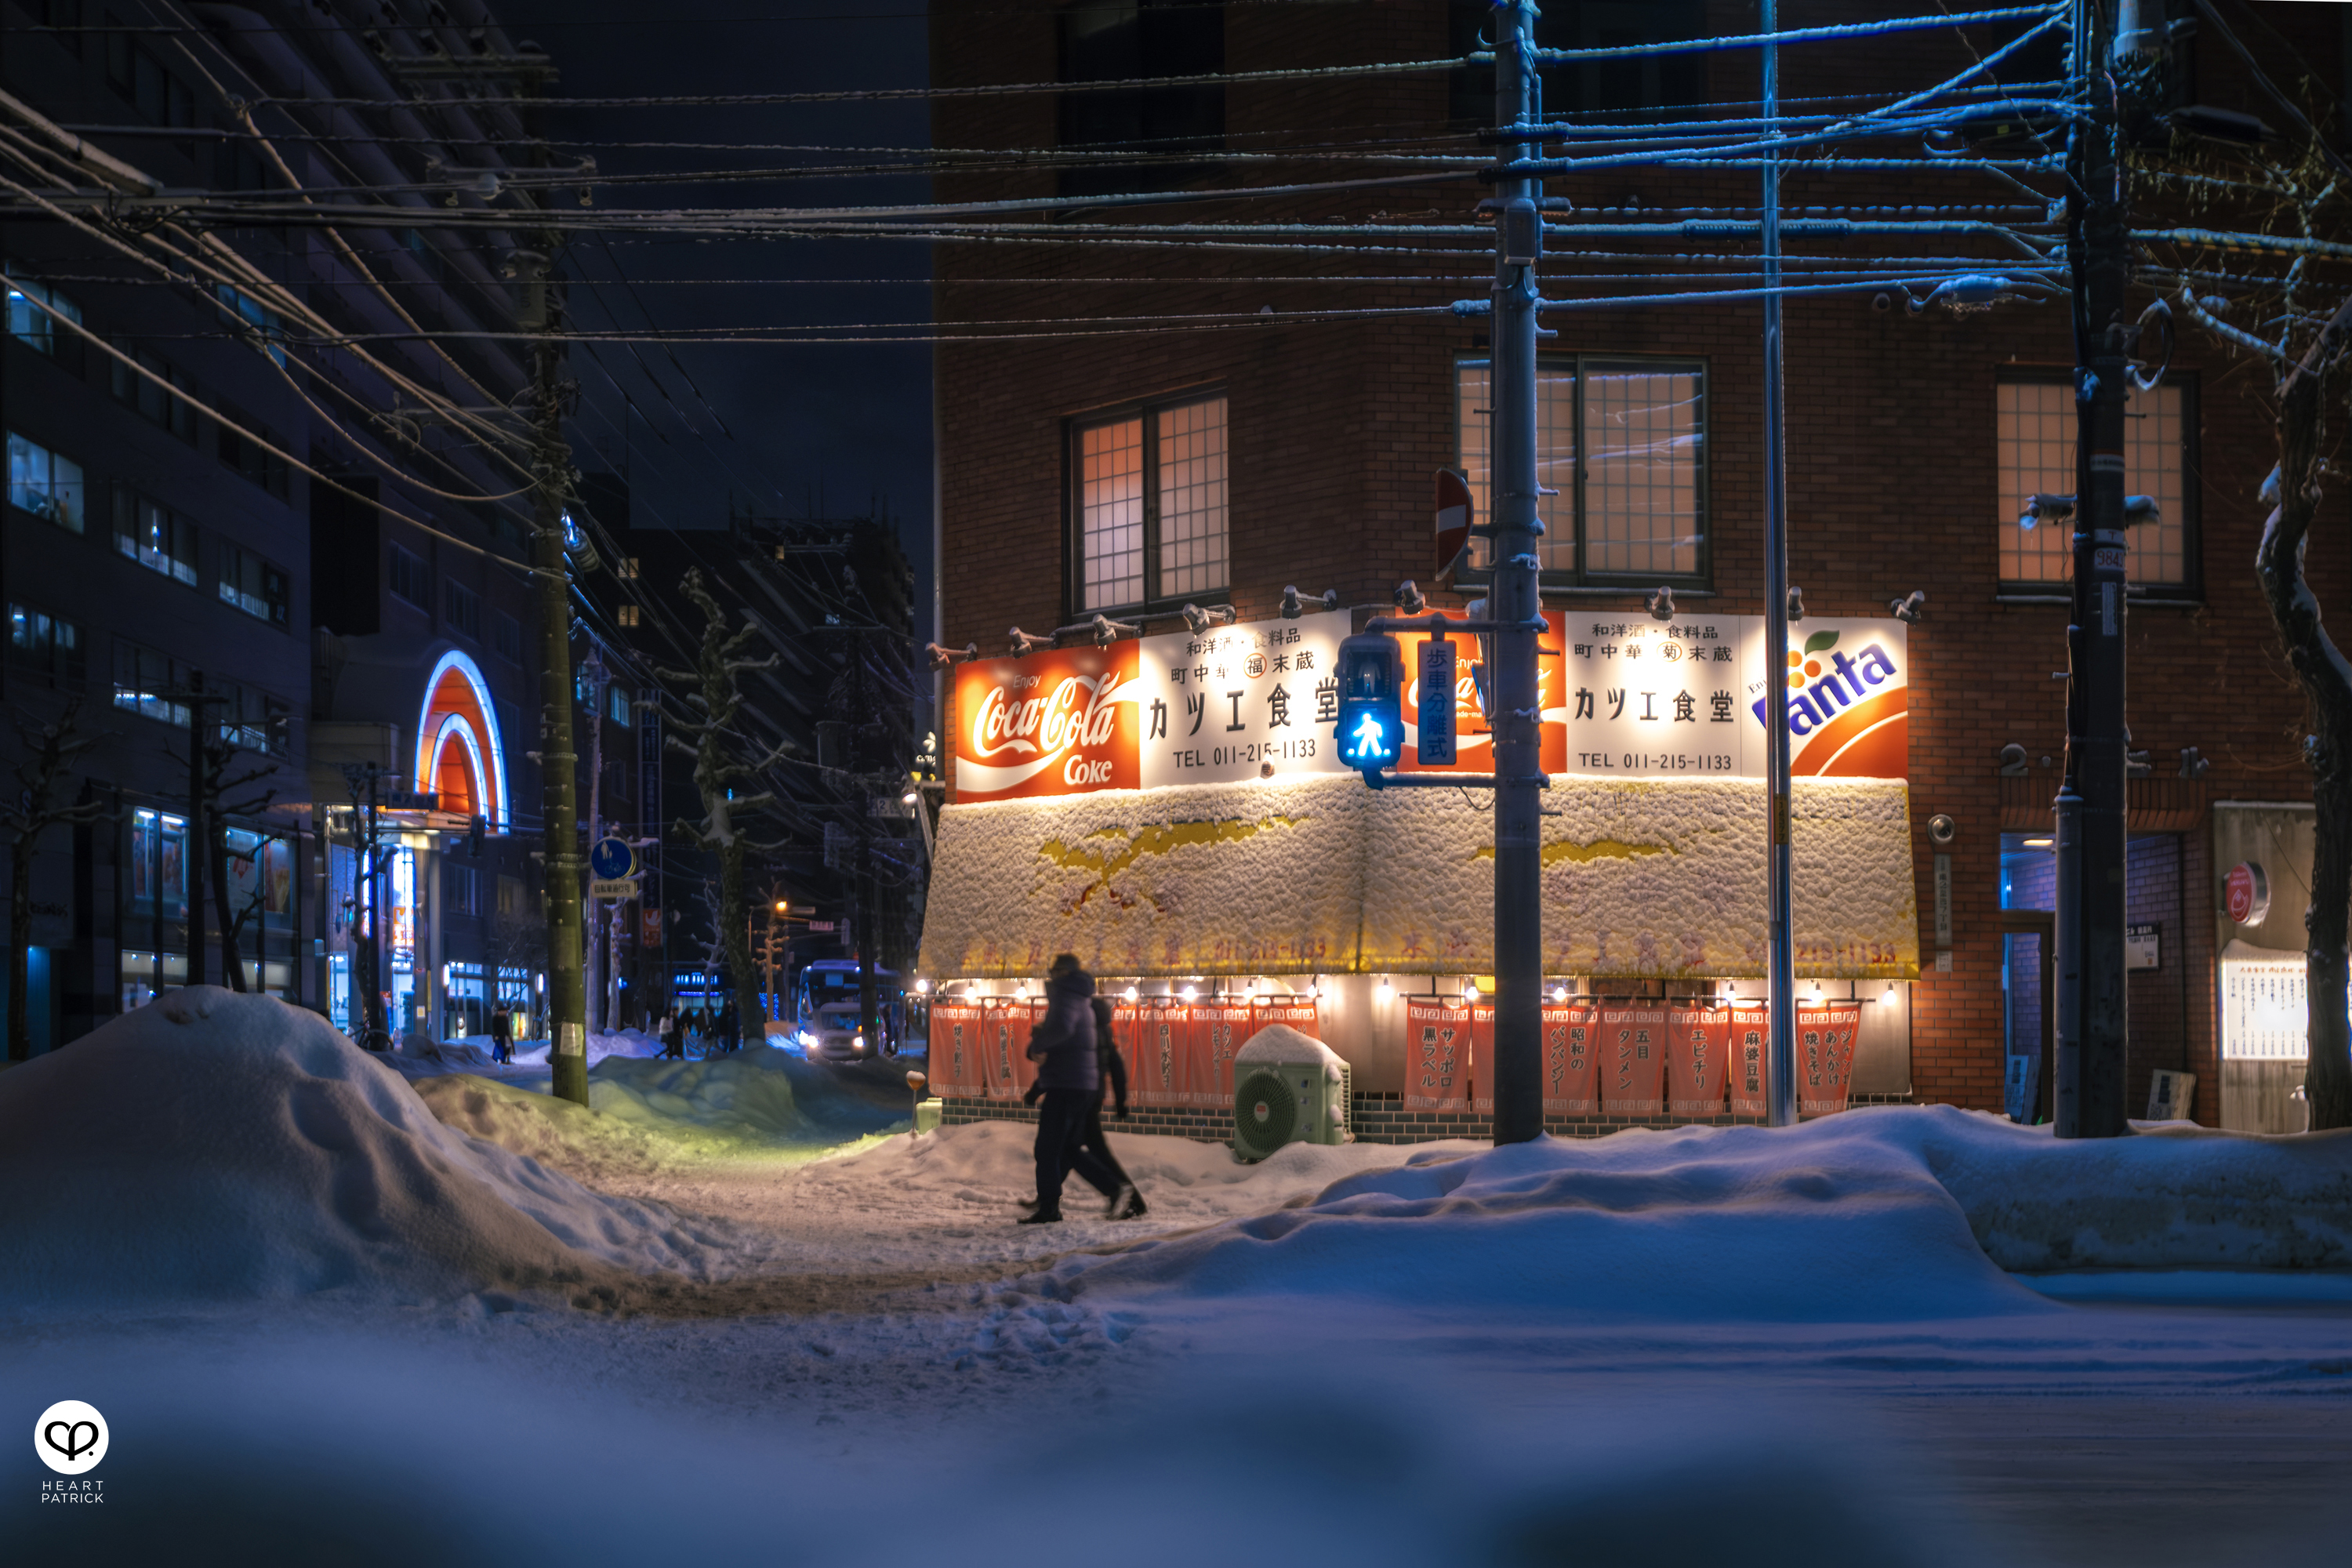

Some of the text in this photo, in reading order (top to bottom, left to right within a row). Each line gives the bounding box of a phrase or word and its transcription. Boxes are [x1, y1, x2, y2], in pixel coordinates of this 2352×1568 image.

[1013, 674, 1042, 689] Enjoy
[1426, 648, 1448, 758] 歩車分離式
[1574, 686, 1734, 723] カツエ食堂
[972, 670, 1121, 758] Coca-Cola
[1063, 754, 1113, 786] Coke
[1173, 739, 1316, 768] TEL 011-215-1133
[1578, 753, 1732, 770] TEL 011-215-1133
[1421, 1025, 1438, 1087] 黒ラベル
[1439, 1027, 1456, 1088] サッポロ
[1550, 1024, 1566, 1095] バンバンジー
[1570, 1026, 1586, 1070] 昭和の
[1618, 1029, 1632, 1090] タンメン
[1635, 1029, 1651, 1060] 五目
[1690, 1029, 1708, 1090] エビチリ
[1744, 1029, 1762, 1093] 麻婆豆腐
[1804, 1029, 1823, 1087] 焼きそば
[1824, 1029, 1840, 1086] あんかけ
